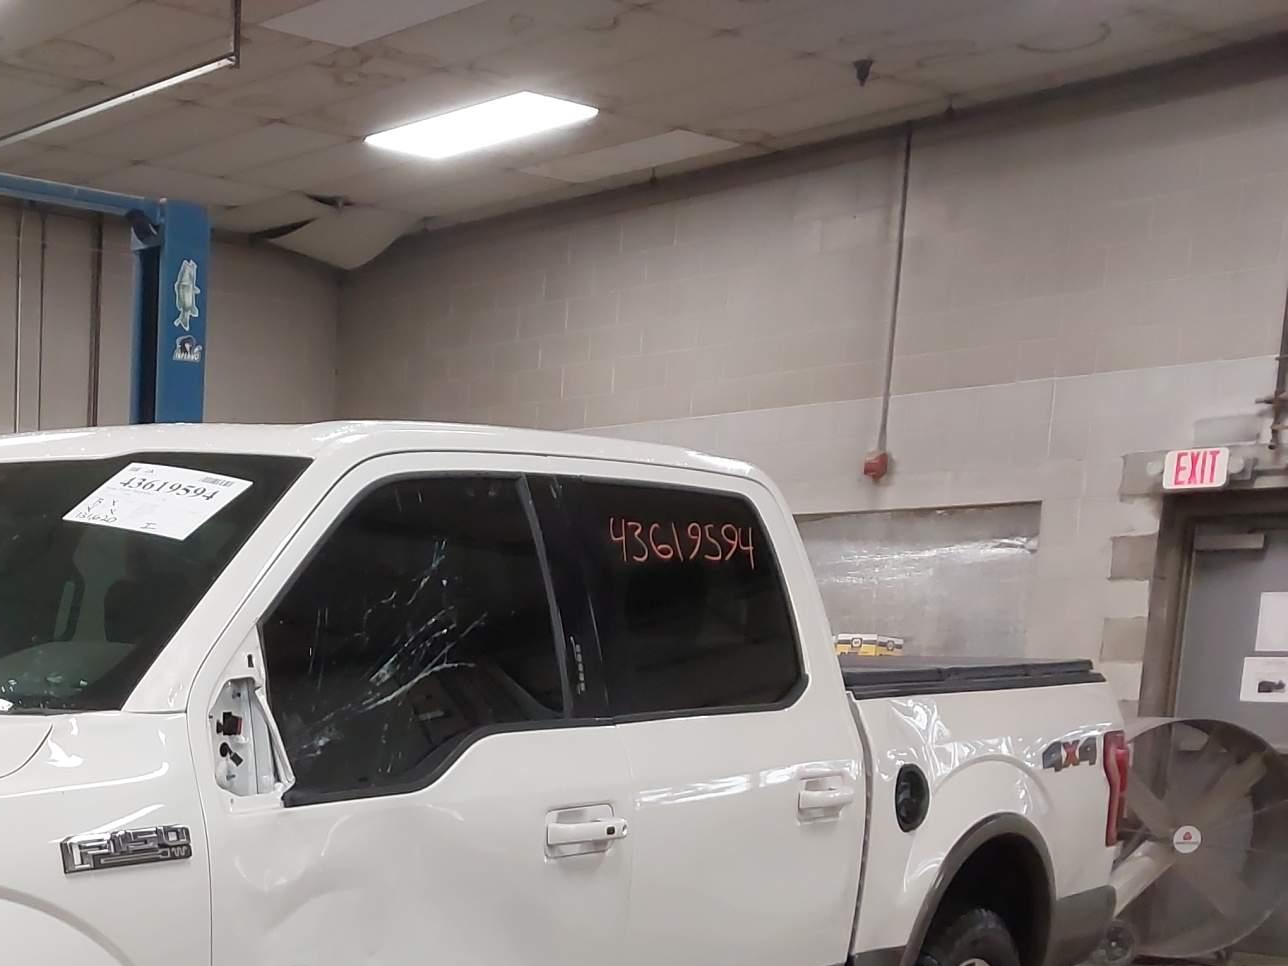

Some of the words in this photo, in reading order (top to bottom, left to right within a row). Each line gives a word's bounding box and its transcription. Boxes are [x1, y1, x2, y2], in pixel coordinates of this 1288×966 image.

[1174, 450, 1221, 485] EXIT
[119, 476, 221, 501] 43619594
[609, 517, 755, 570] 43619594
